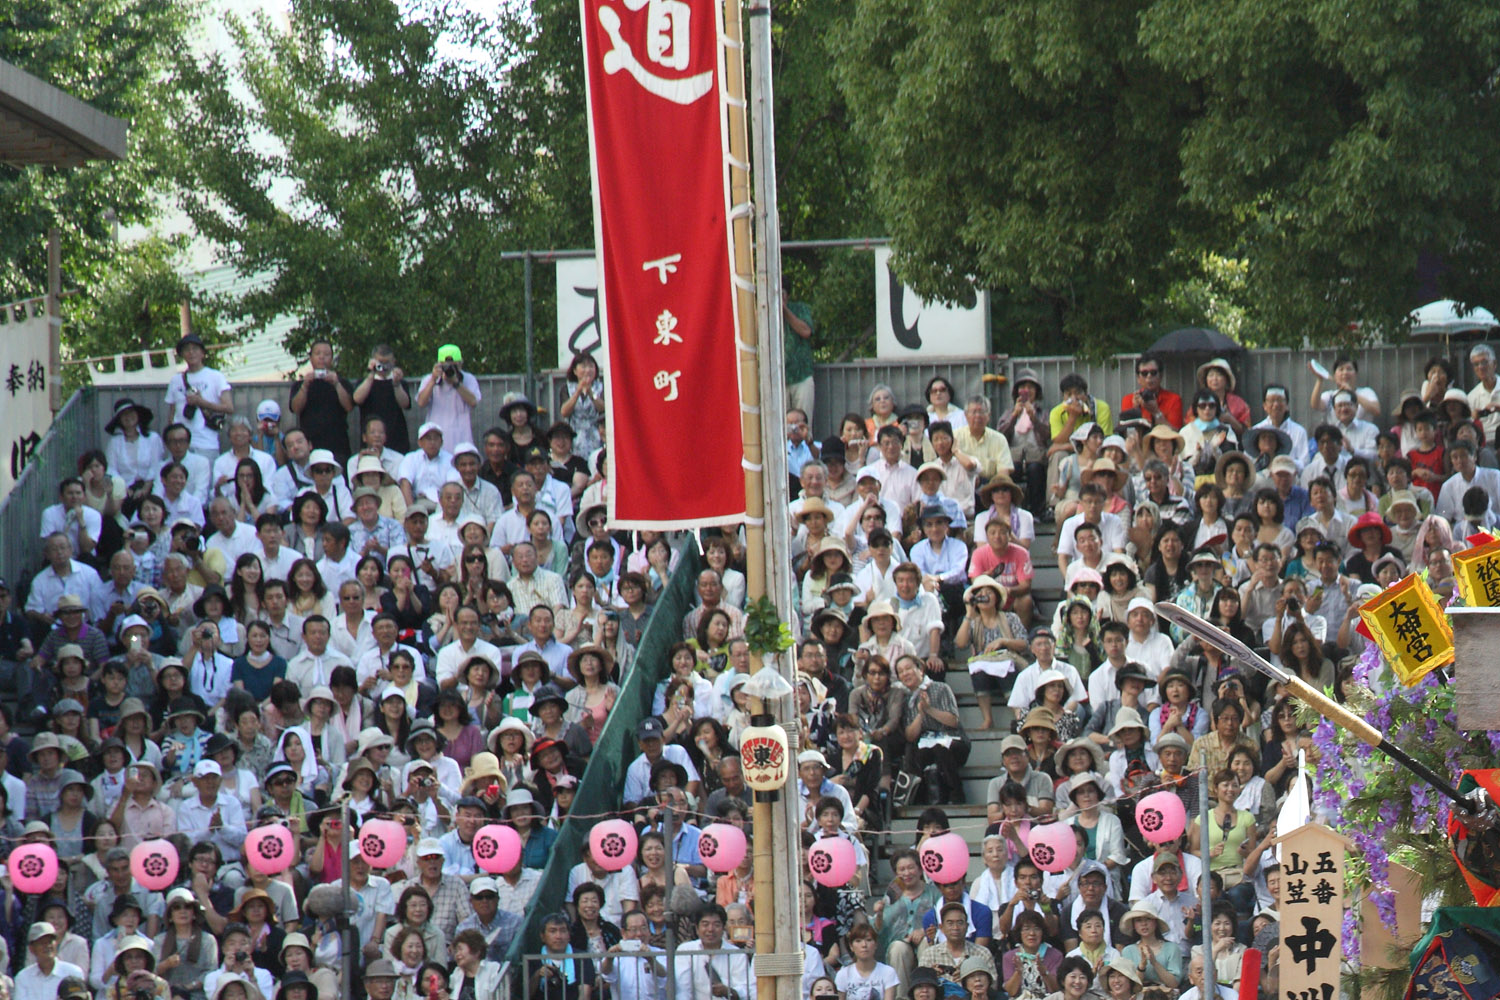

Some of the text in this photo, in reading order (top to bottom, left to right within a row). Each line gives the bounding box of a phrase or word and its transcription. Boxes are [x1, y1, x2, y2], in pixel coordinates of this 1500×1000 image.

[642, 253, 683, 402] 下東町
[6, 360, 45, 397] 奉納
[1388, 600, 1434, 663] 大神宮
